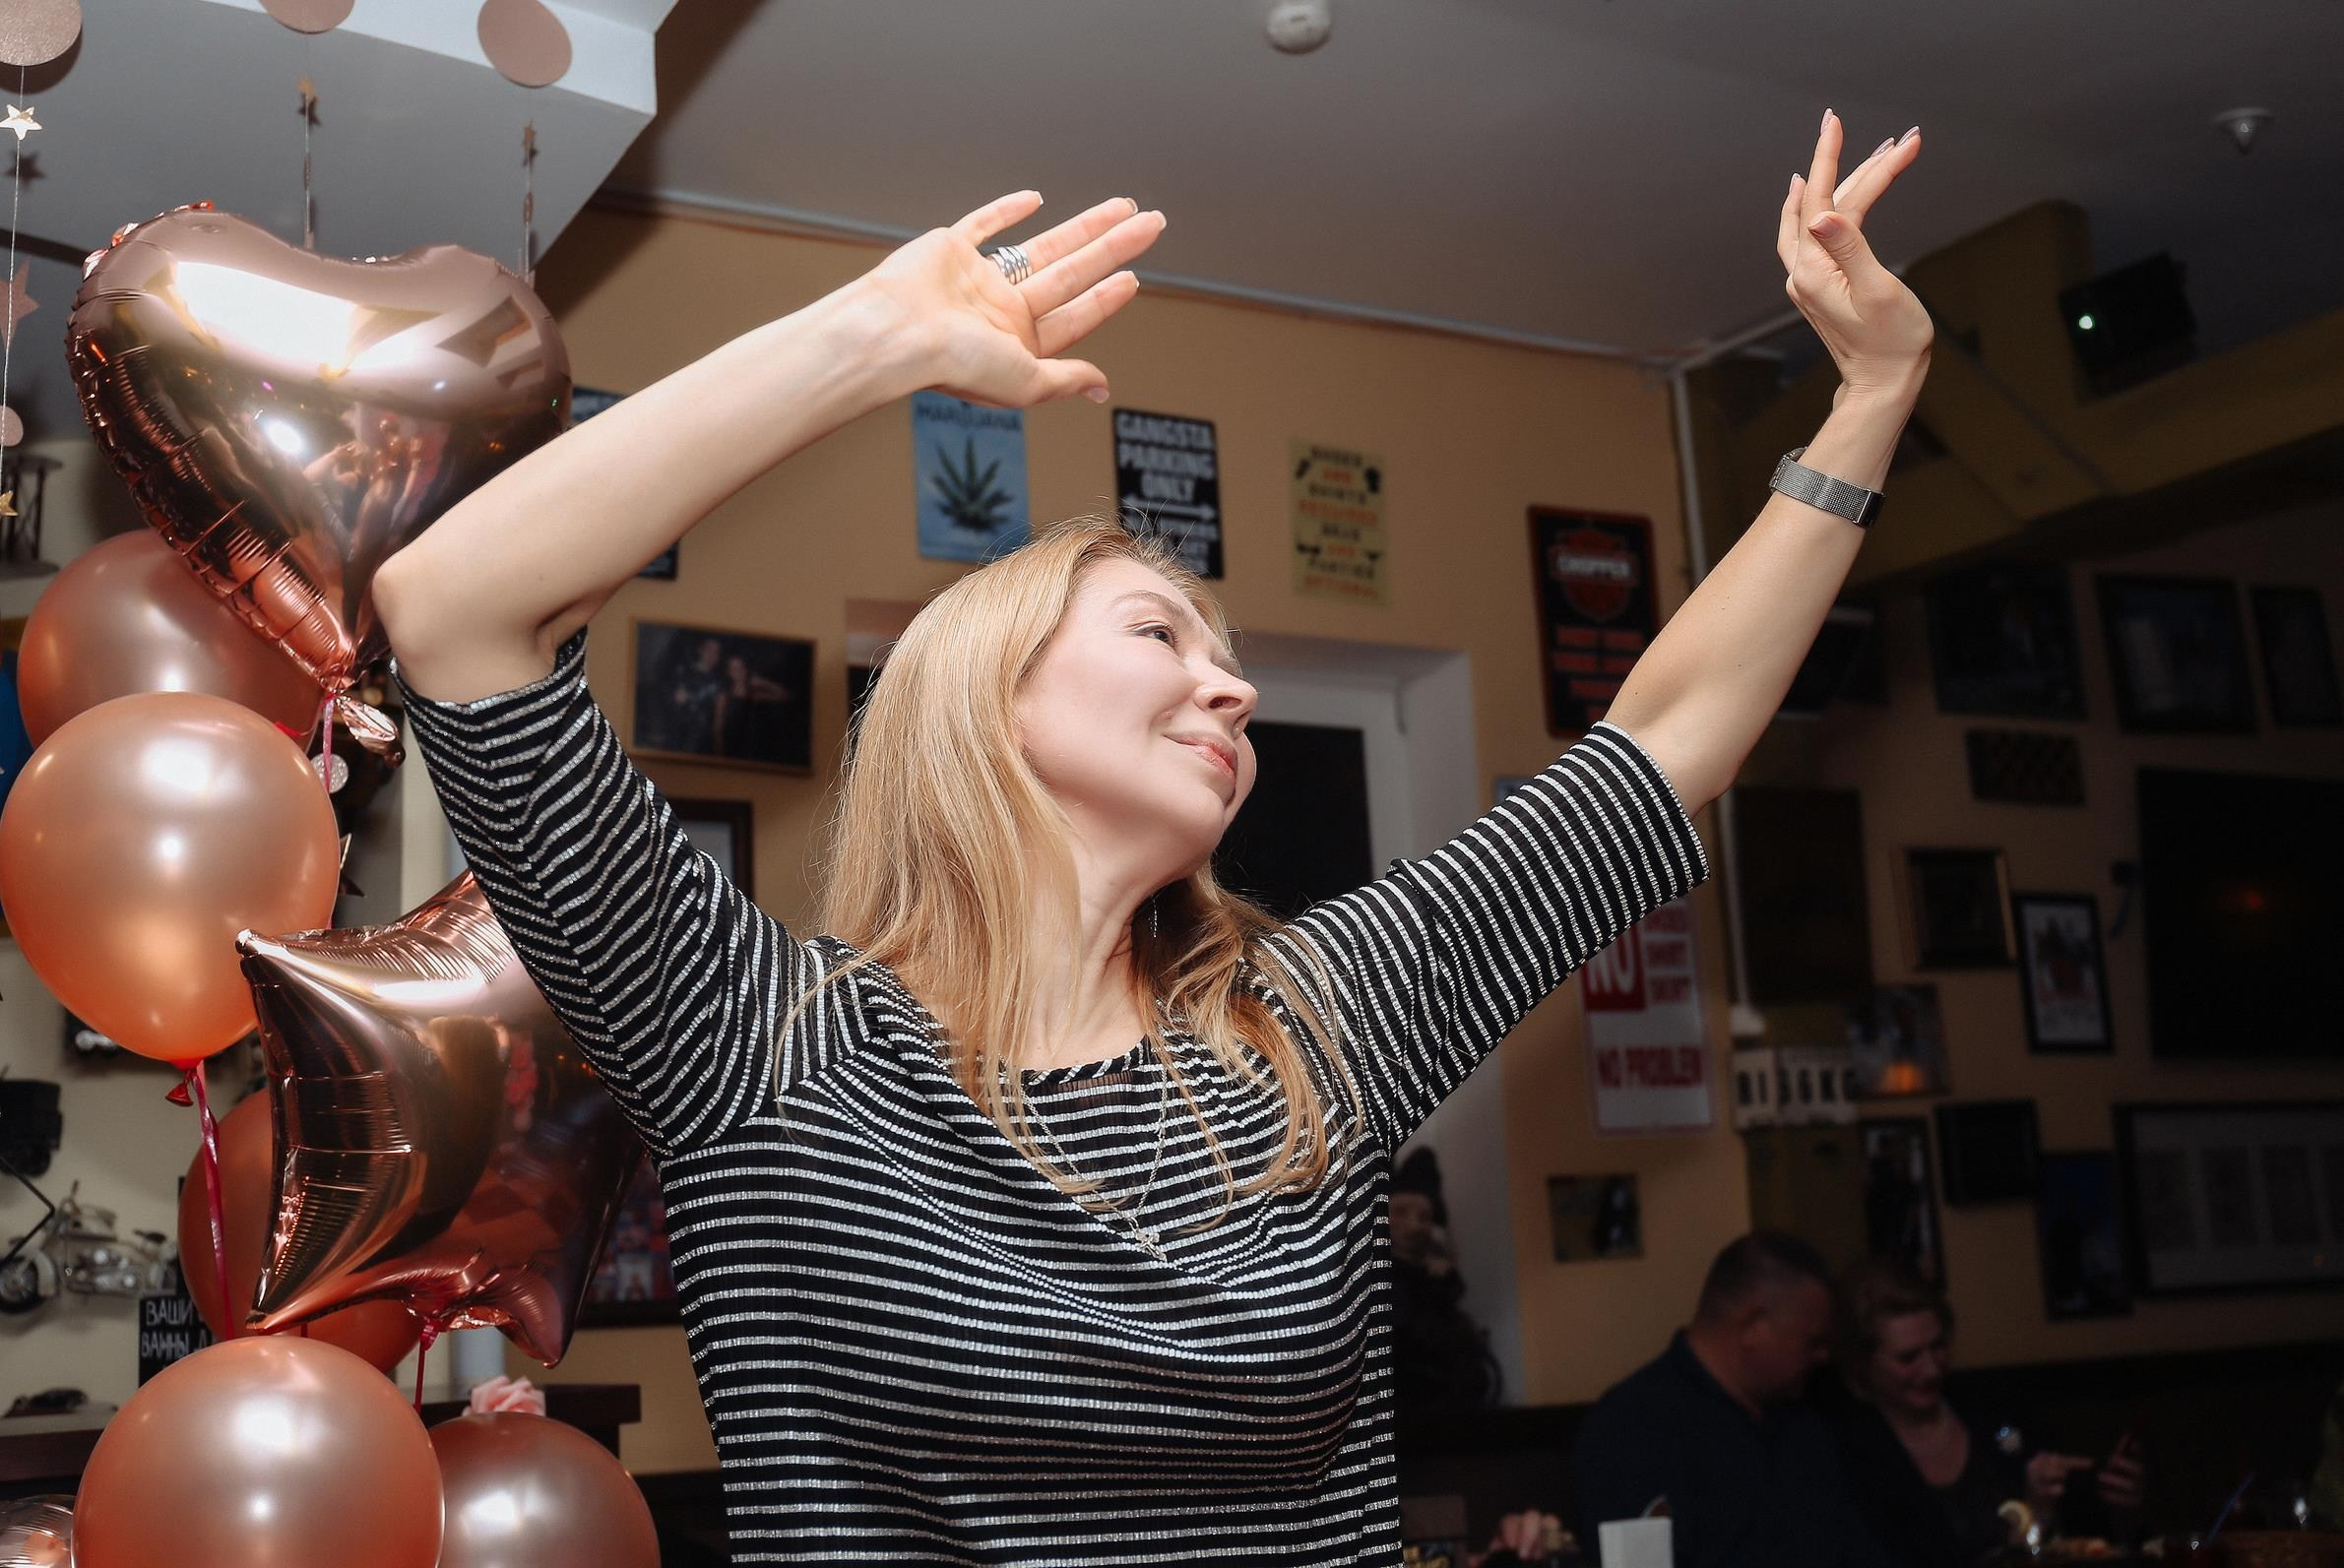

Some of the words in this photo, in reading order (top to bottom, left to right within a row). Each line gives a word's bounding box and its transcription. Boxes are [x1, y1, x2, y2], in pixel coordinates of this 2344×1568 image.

[1117, 413, 1213, 449] GANGSTA
[1118, 444, 1214, 479] PARKING
[1141, 472, 1194, 504] ONLY
[1557, 554, 1631, 579] CHOPPER
[1597, 1048, 1621, 1089] NO
[1626, 1045, 1704, 1088] PROBLEM
[146, 1299, 193, 1326] ВАШИ
